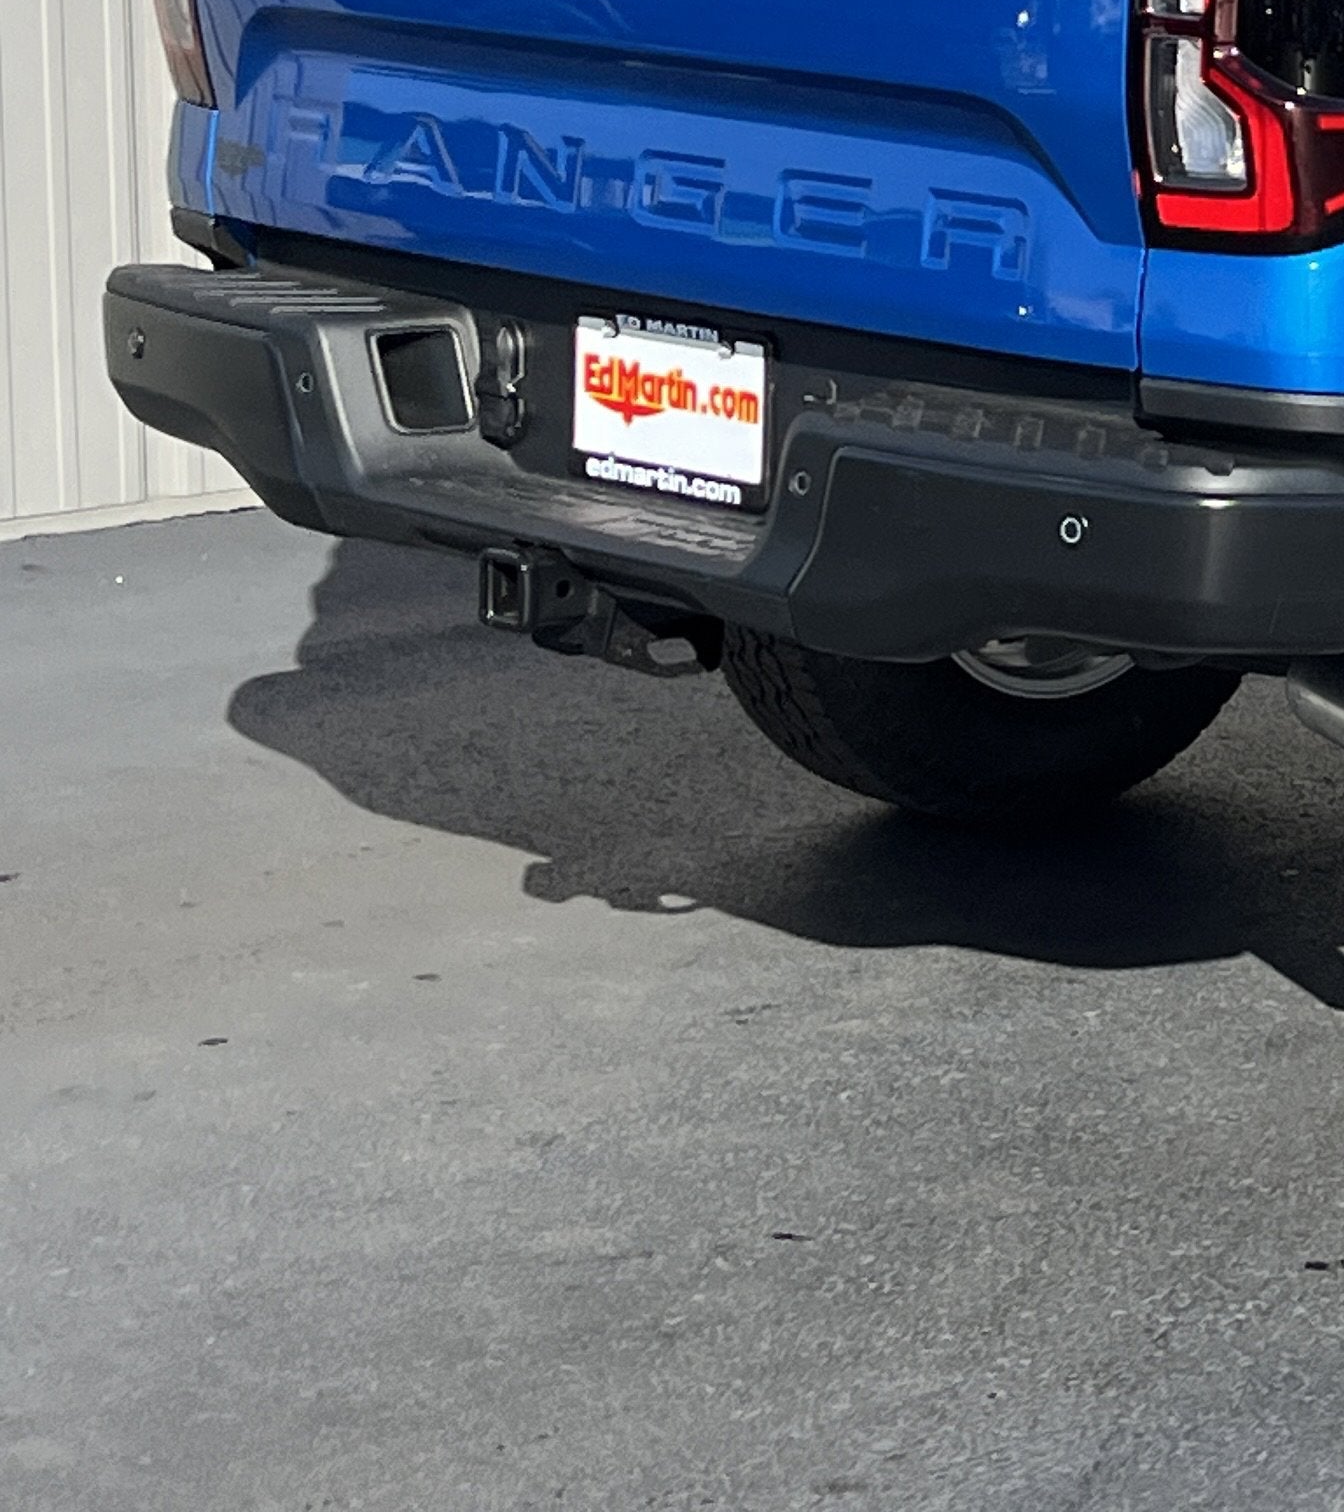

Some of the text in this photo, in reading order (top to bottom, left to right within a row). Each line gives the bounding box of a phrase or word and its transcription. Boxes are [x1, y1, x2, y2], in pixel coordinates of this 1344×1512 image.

[646, 318, 719, 343] MARTIN
[583, 353, 759, 426] EdMartin.com
[584, 456, 742, 505] edmartin.com
